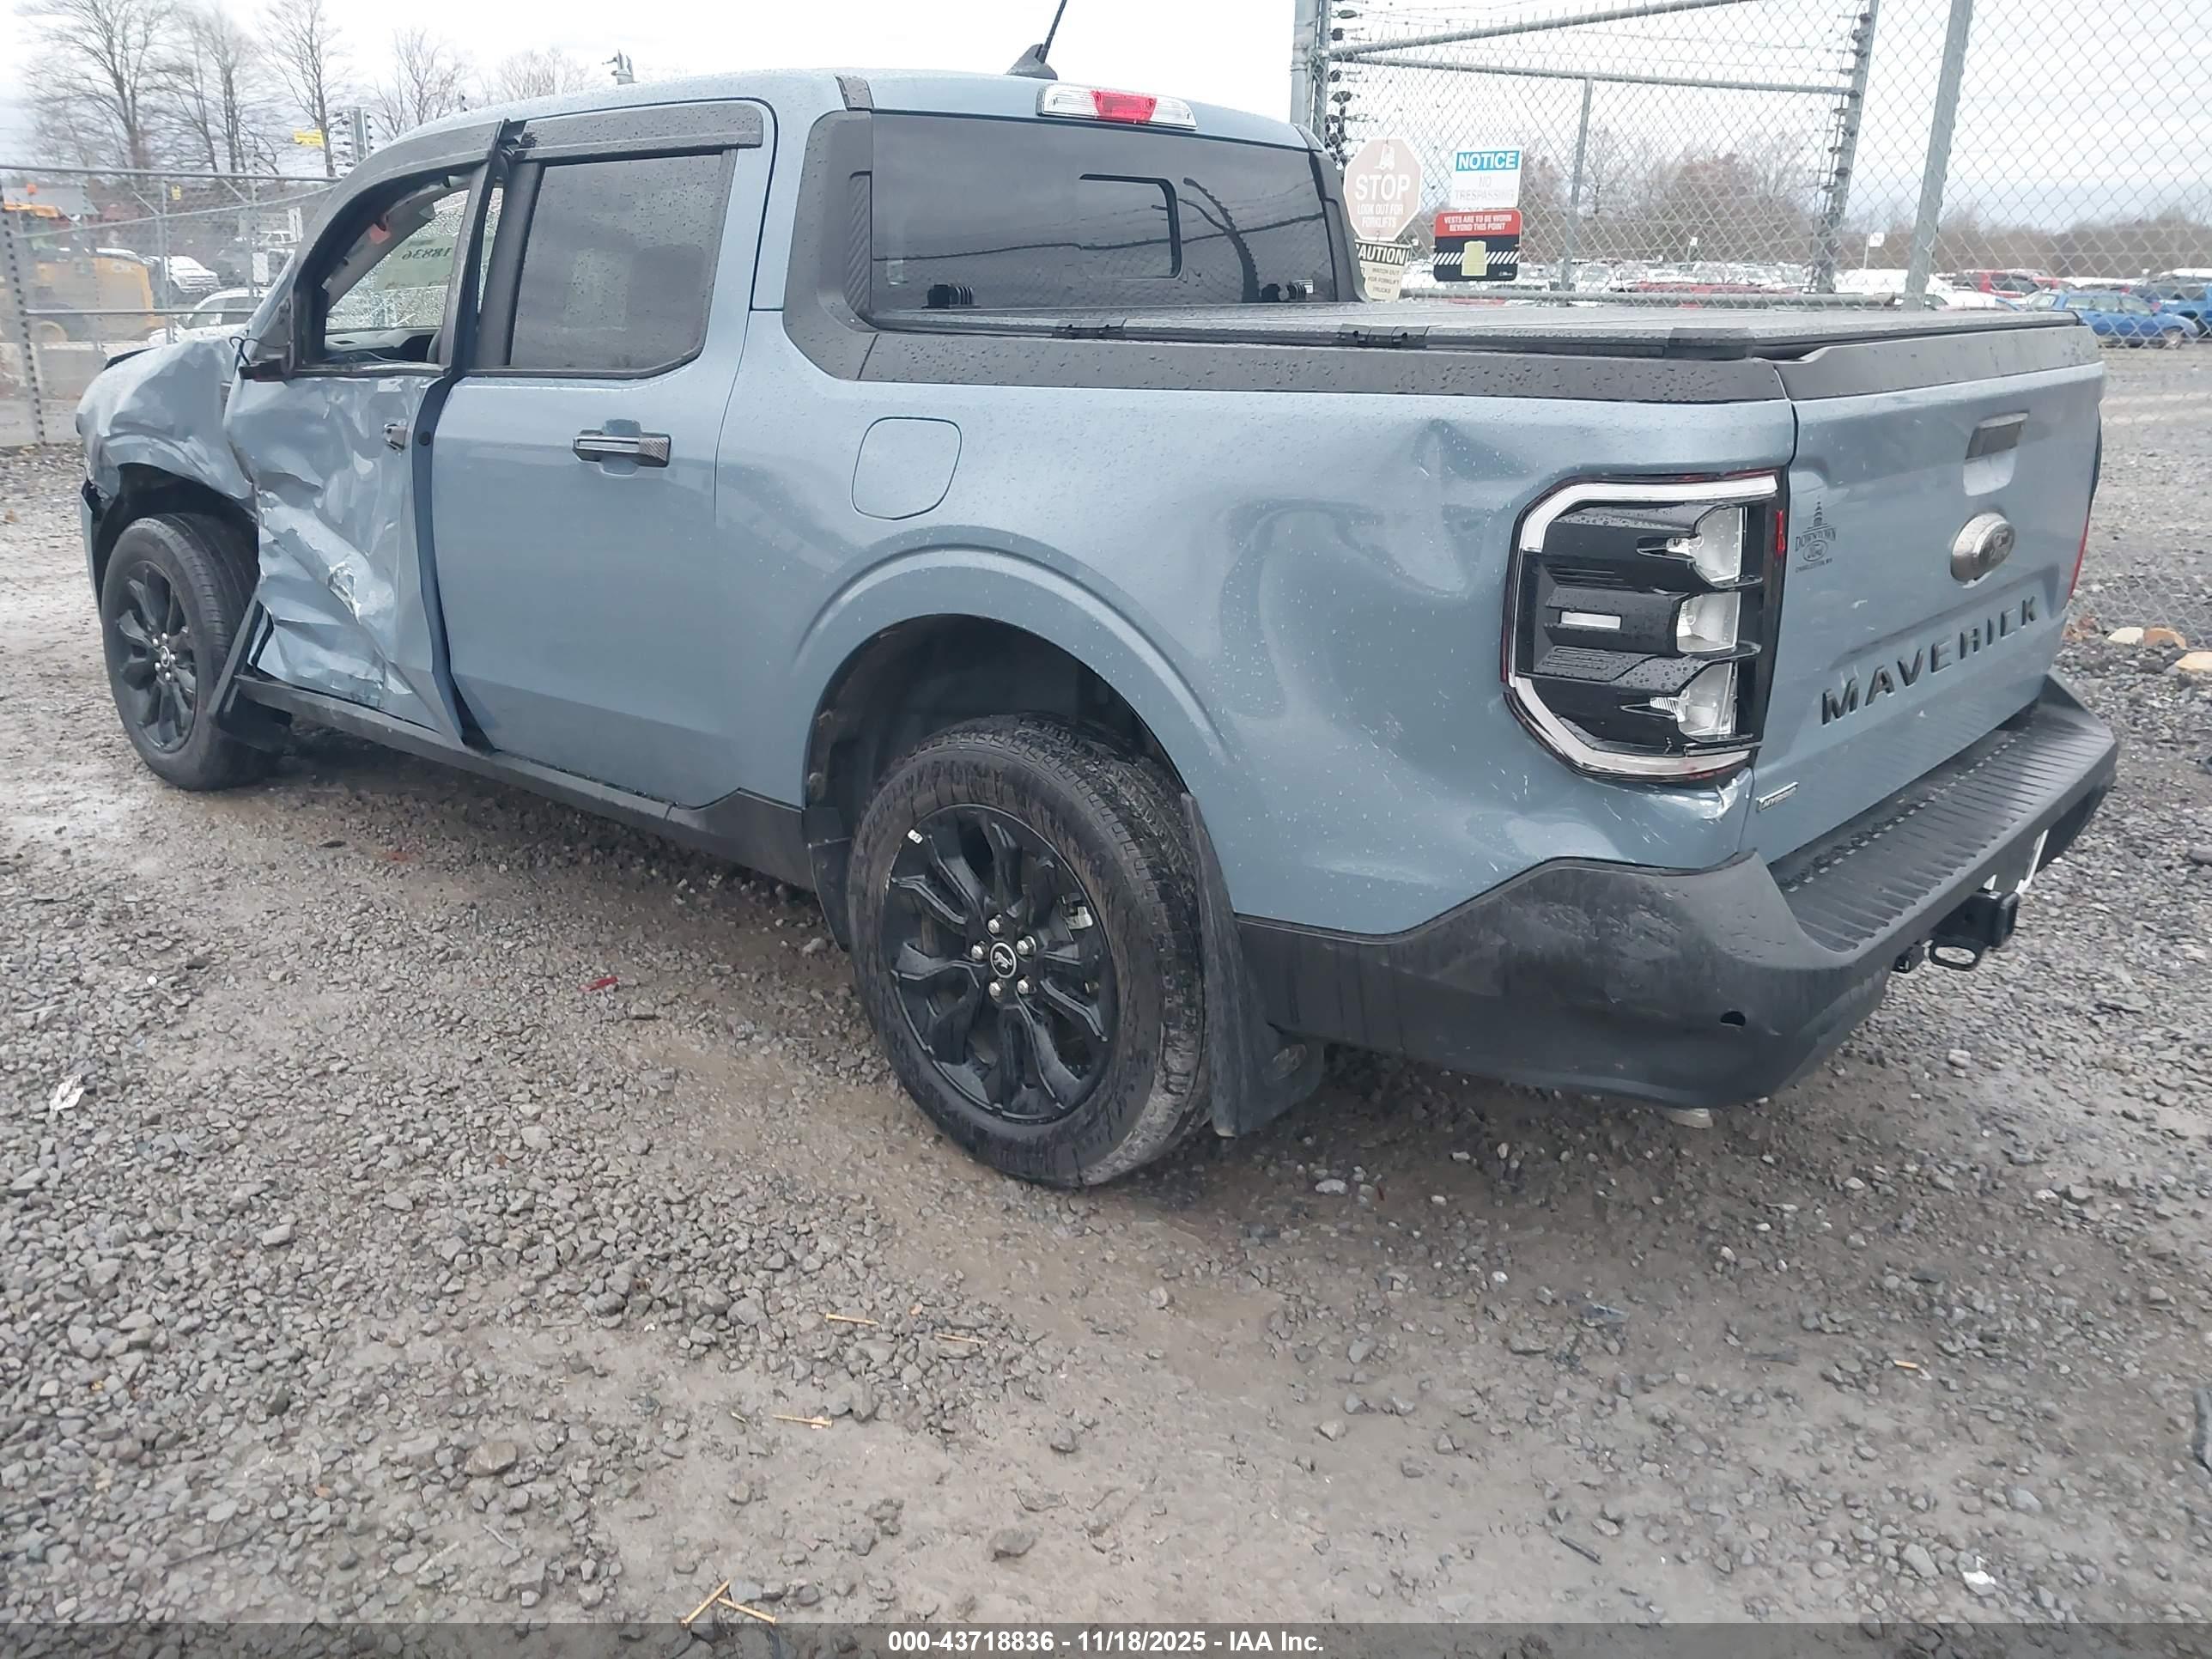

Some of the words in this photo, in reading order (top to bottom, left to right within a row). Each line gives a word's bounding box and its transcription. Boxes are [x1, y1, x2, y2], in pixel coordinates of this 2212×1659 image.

[1457, 153, 1517, 169] NOTICE
[1479, 175, 1492, 187] NO
[1355, 174, 1410, 201] STOP
[1455, 189, 1514, 200] TRESPASSING
[1357, 204, 1374, 215] LOOK
[1375, 204, 1389, 215] OUT
[1389, 204, 1404, 216] FOR
[1362, 216, 1397, 228] FORKLIFTS
[1443, 216, 1462, 224] VESTS
[1820, 596, 2037, 726] MAVERICK
